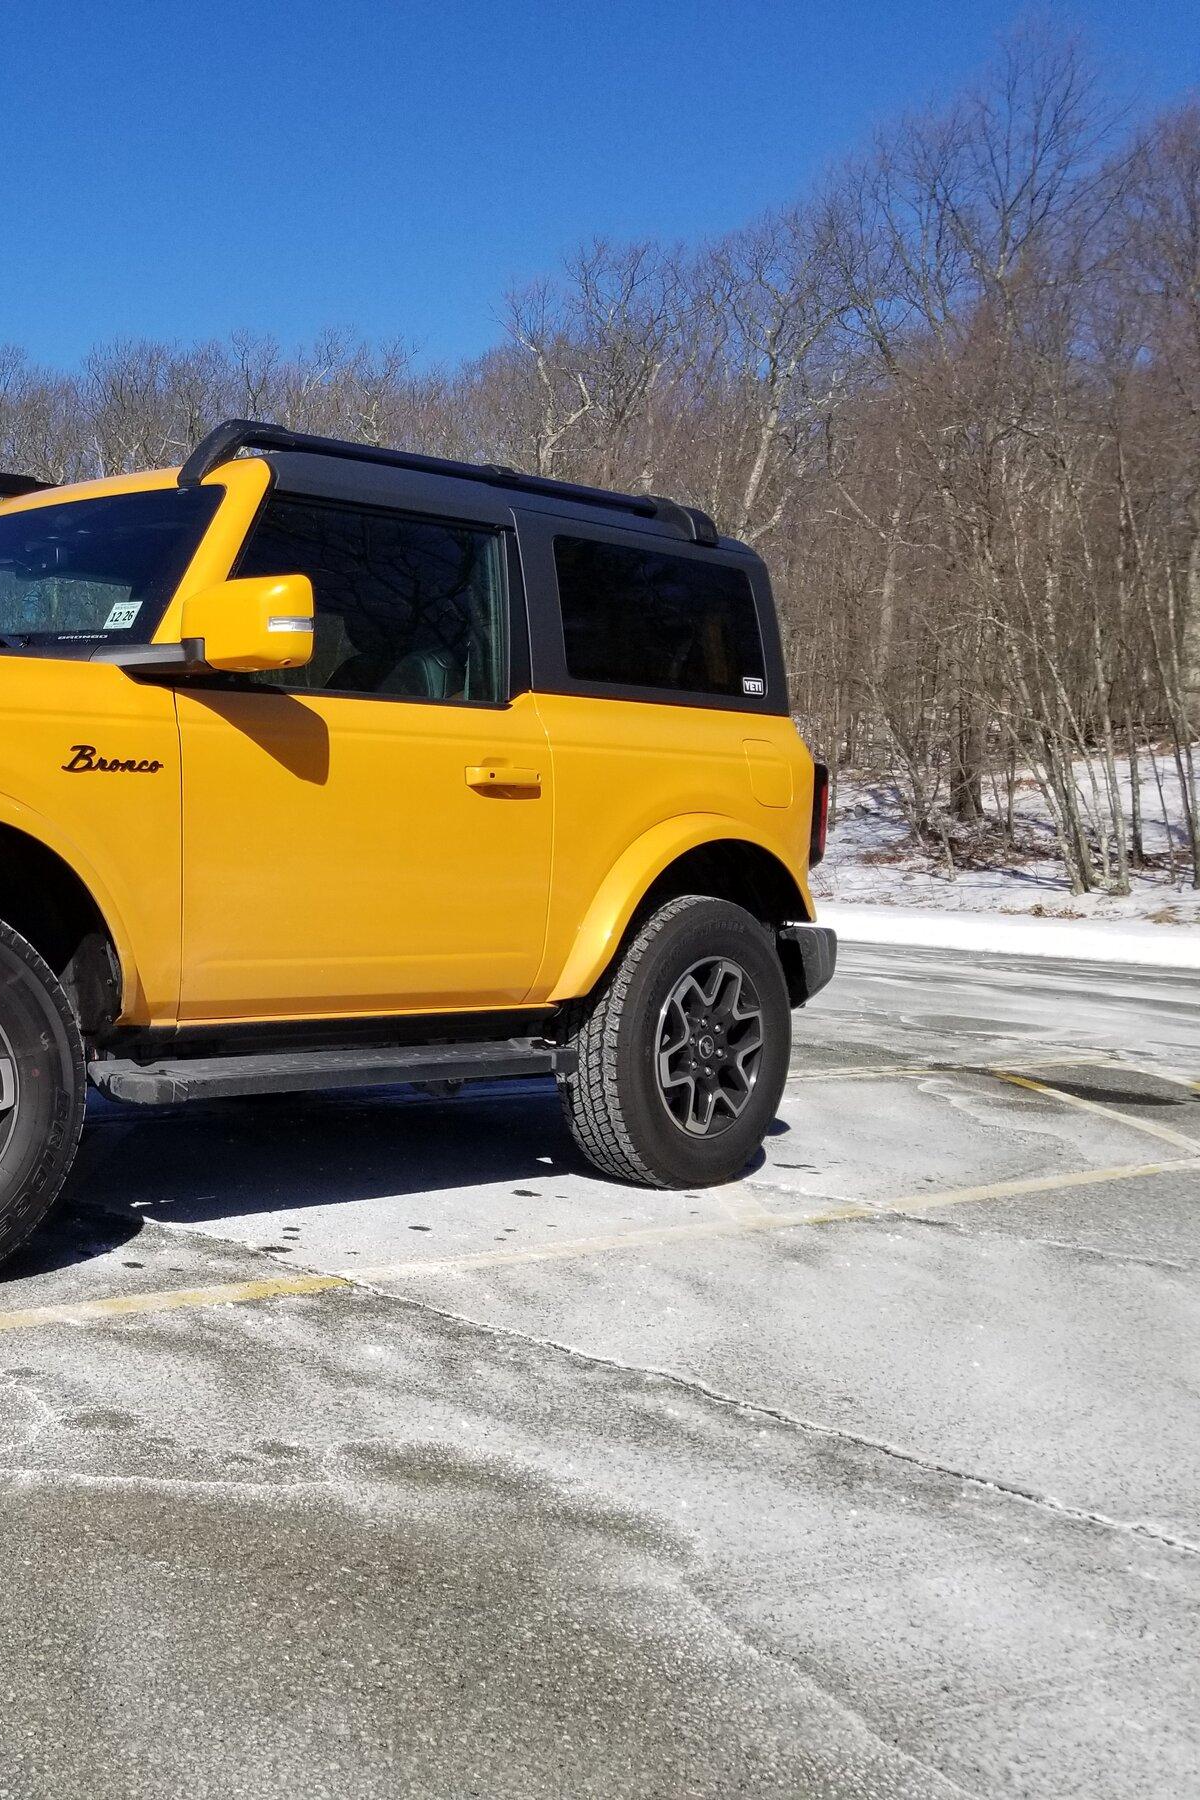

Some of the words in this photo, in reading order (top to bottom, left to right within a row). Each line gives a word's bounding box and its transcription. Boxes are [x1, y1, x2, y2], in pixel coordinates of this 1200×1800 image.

[110, 612, 123, 622] 12
[122, 611, 135, 621] 26
[744, 680, 762, 692] YETI
[61, 745, 165, 774] Bronco
